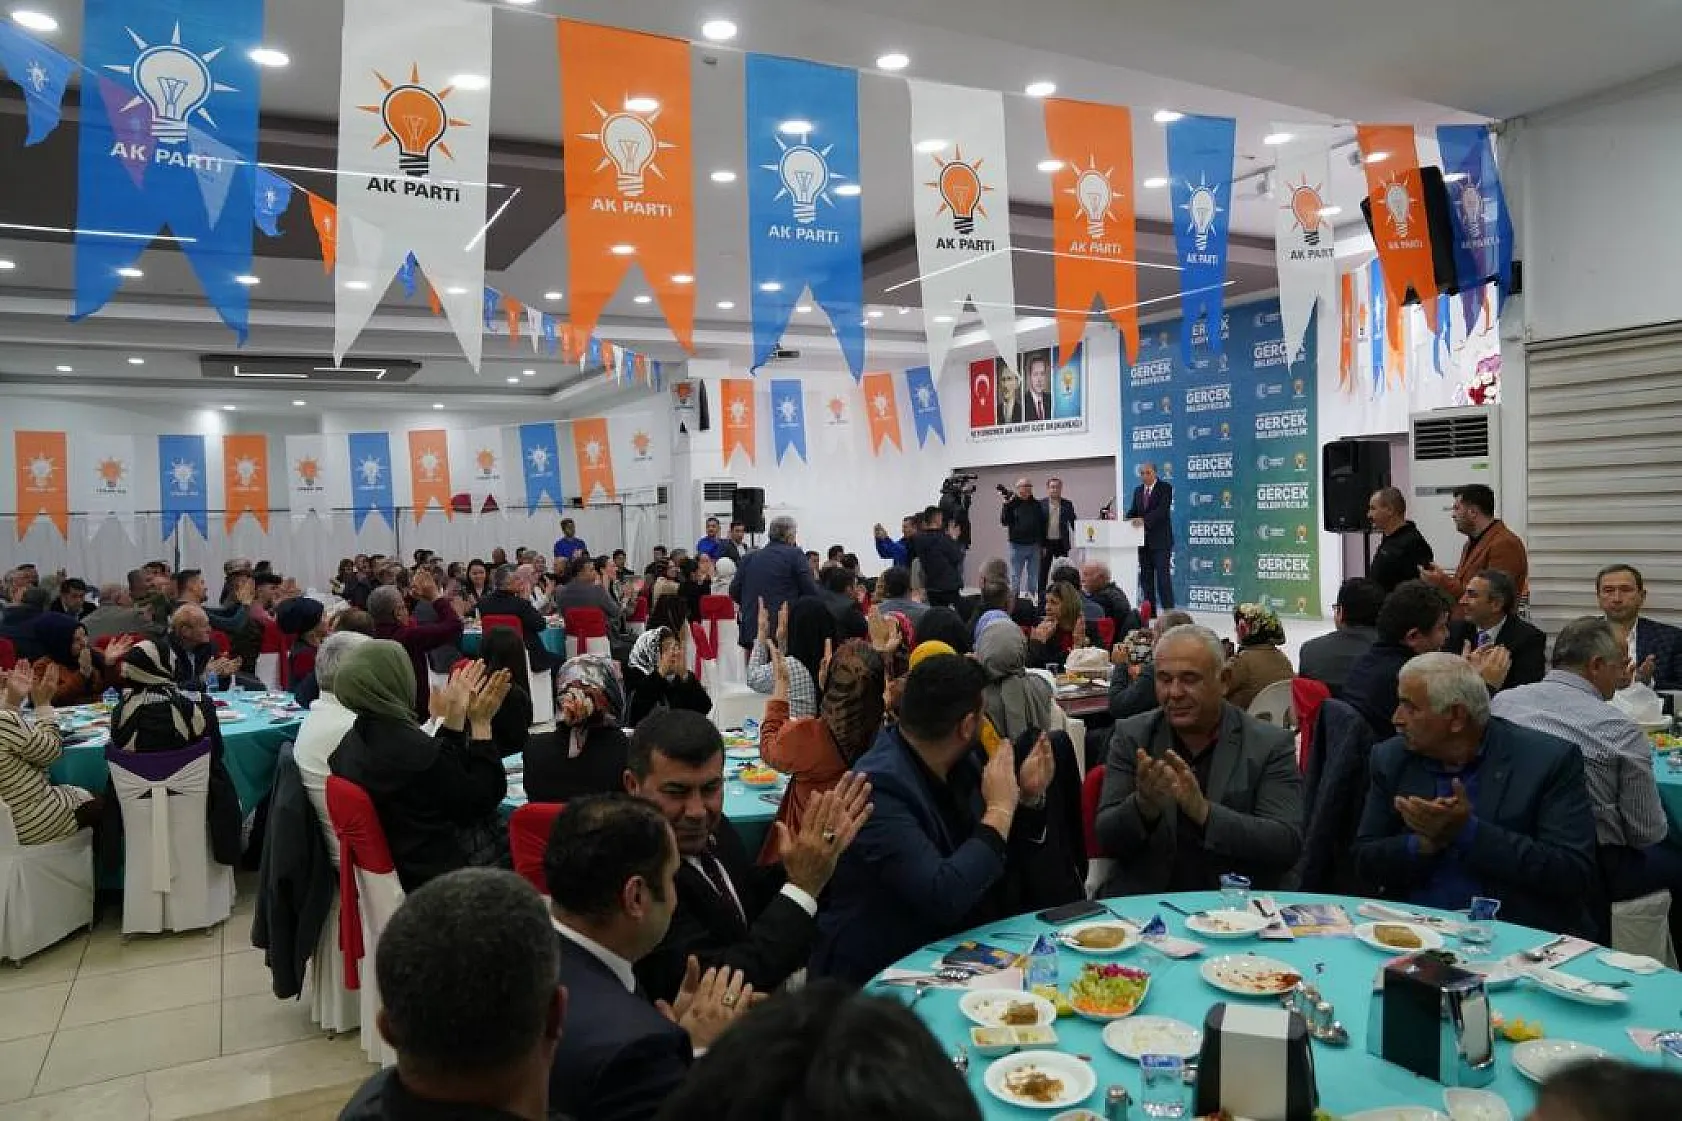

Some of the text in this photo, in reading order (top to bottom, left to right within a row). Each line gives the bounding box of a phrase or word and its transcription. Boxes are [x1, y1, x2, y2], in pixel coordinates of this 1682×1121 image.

[110, 140, 146, 162] AK
[366, 176, 398, 194] AK
[590, 198, 619, 213] AK
[767, 224, 793, 239] AK
[936, 237, 956, 251] AK
[1069, 241, 1089, 254] AK
[1186, 253, 1197, 265] AK
[1289, 249, 1305, 261] AK
[1131, 362, 1171, 379] GERÇEK
[1187, 388, 1232, 405] GERÇEK
[1256, 414, 1307, 430] GERÇEK
[1132, 427, 1172, 442] GERÇEK
[1188, 458, 1233, 471] GERÇEK
[1257, 486, 1309, 501] GERÇEK
[1189, 523, 1234, 537] GERÇEK
[1258, 556, 1309, 572] GERÇEK
[1189, 589, 1234, 603] GERÇEK
